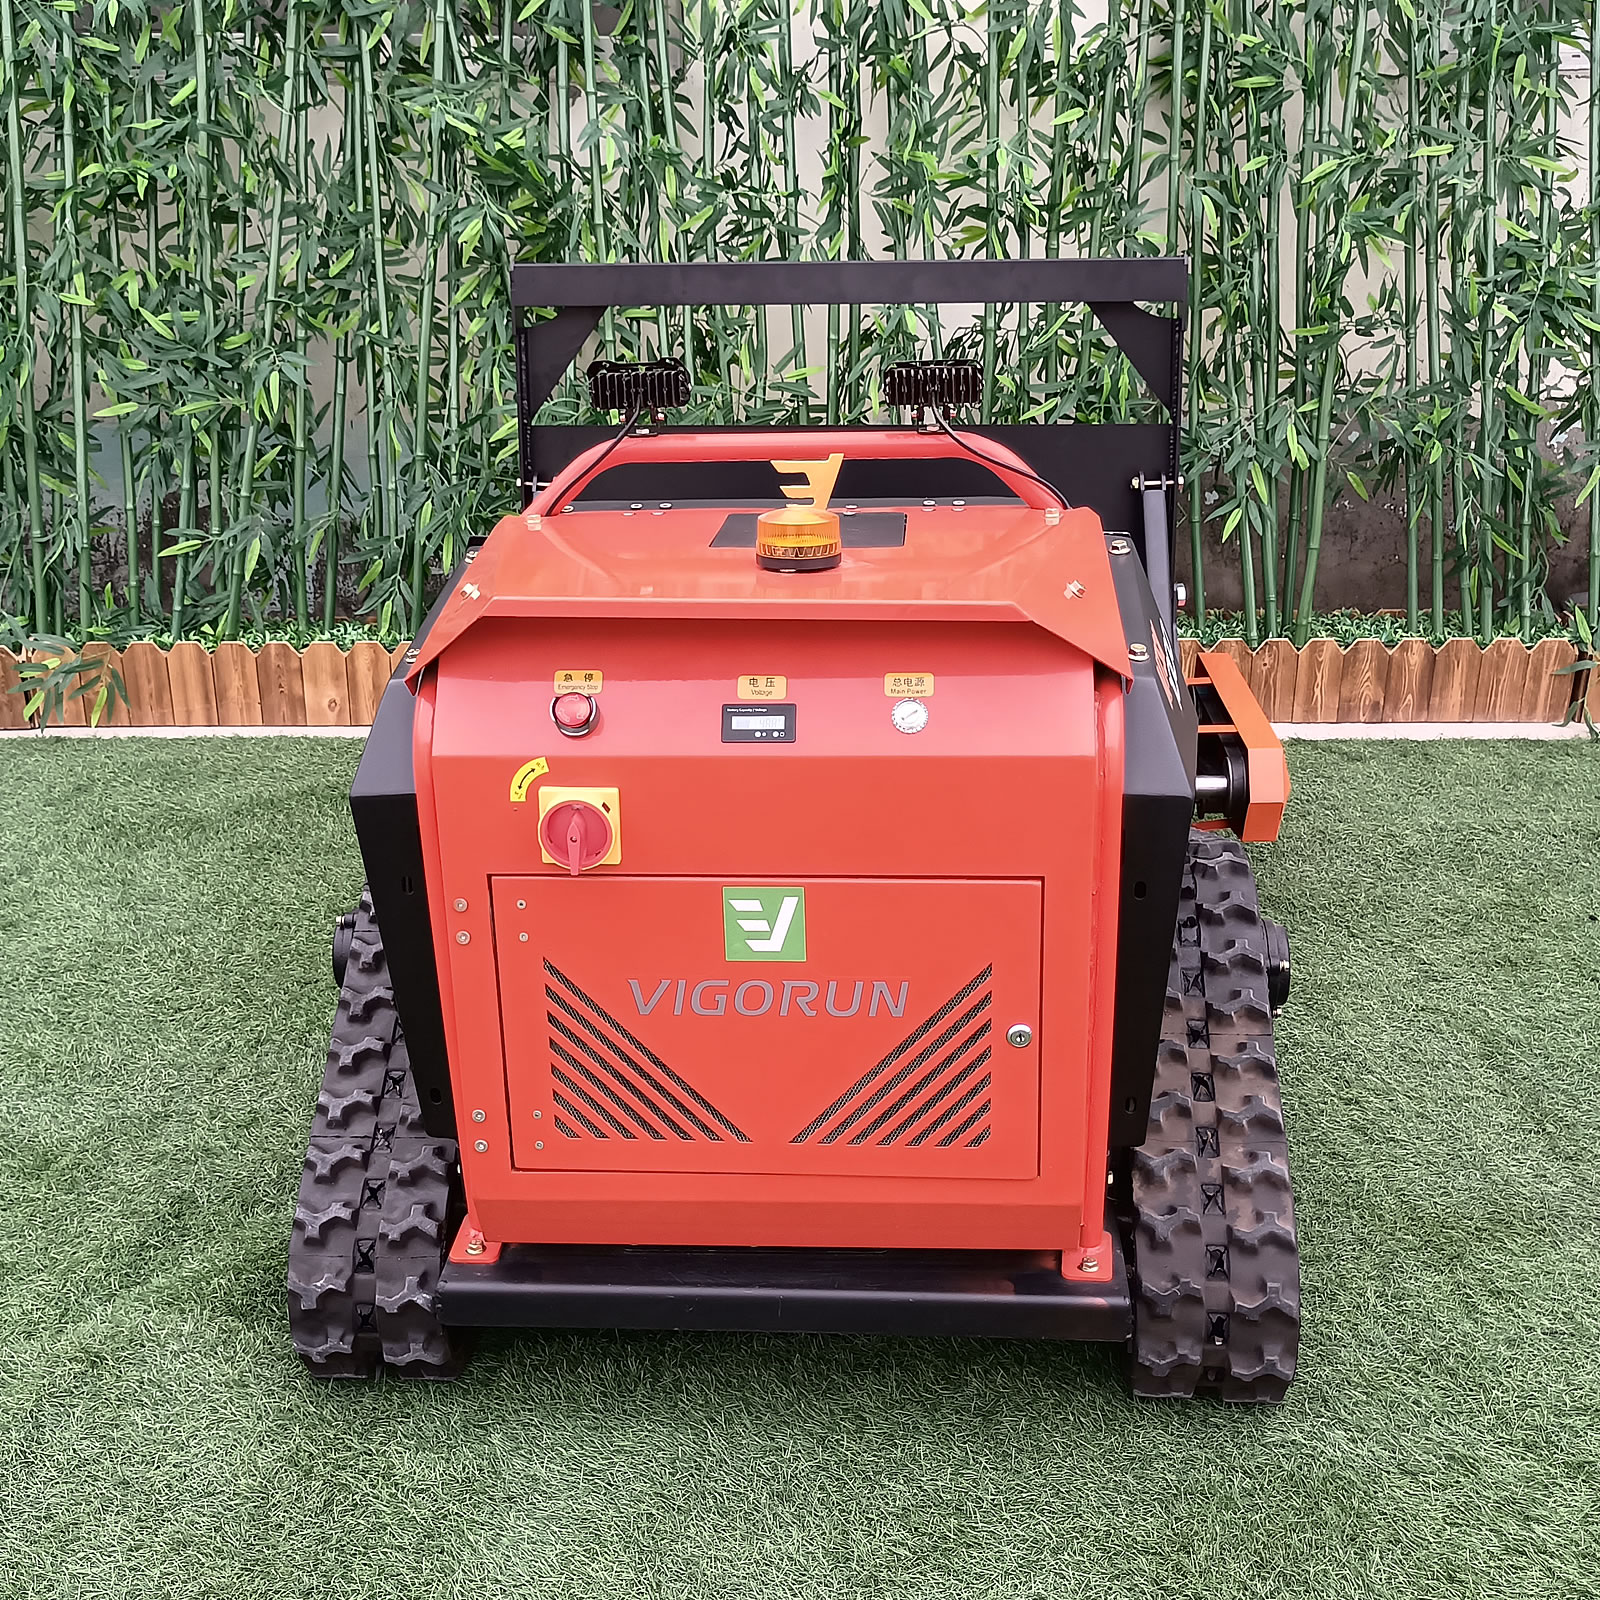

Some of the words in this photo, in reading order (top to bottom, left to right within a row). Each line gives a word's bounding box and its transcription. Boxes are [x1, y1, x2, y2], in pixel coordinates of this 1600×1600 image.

[749, 677, 775, 687] 电压
[893, 677, 925, 687] 总电源
[750, 689, 773, 697] Voltage
[627, 978, 910, 1018] VIGORUN
